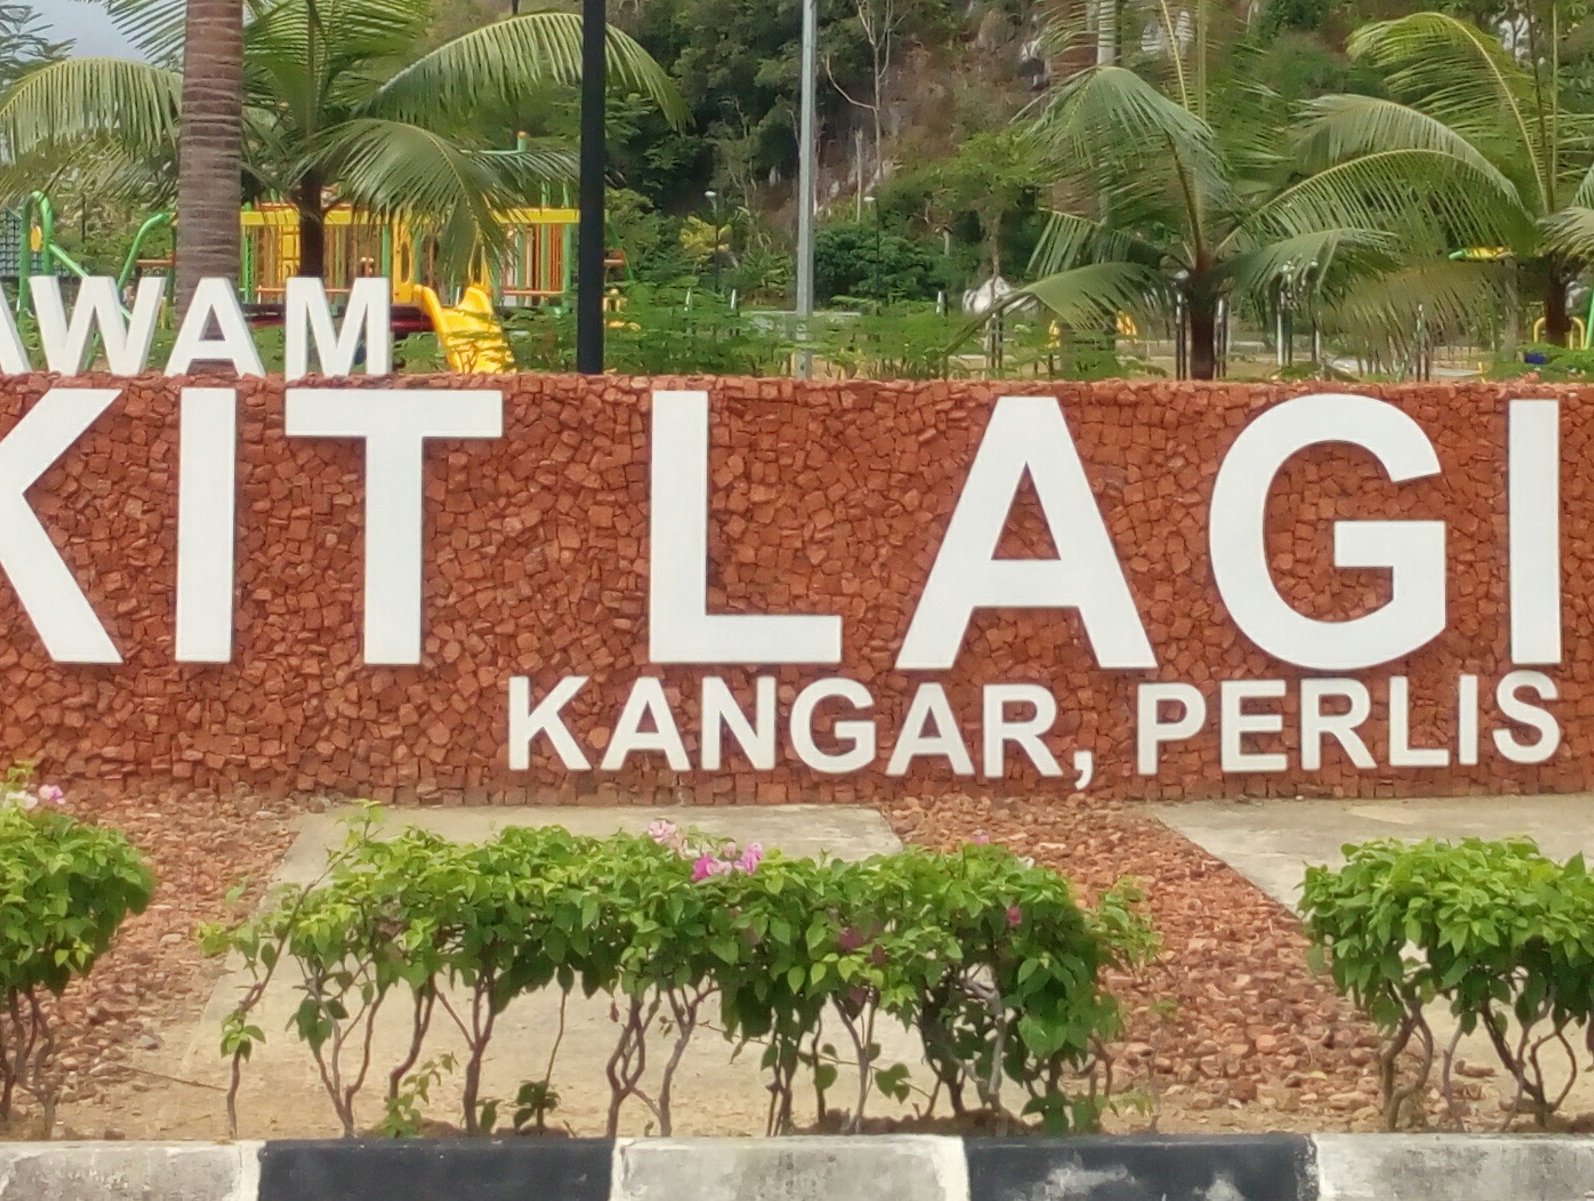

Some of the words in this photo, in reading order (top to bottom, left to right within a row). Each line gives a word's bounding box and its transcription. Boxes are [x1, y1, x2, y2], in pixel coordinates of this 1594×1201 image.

[648, 389, 1561, 671] LAGI
[508, 675, 1095, 791] KANGAR,
[1136, 670, 1562, 775] PERLIS
